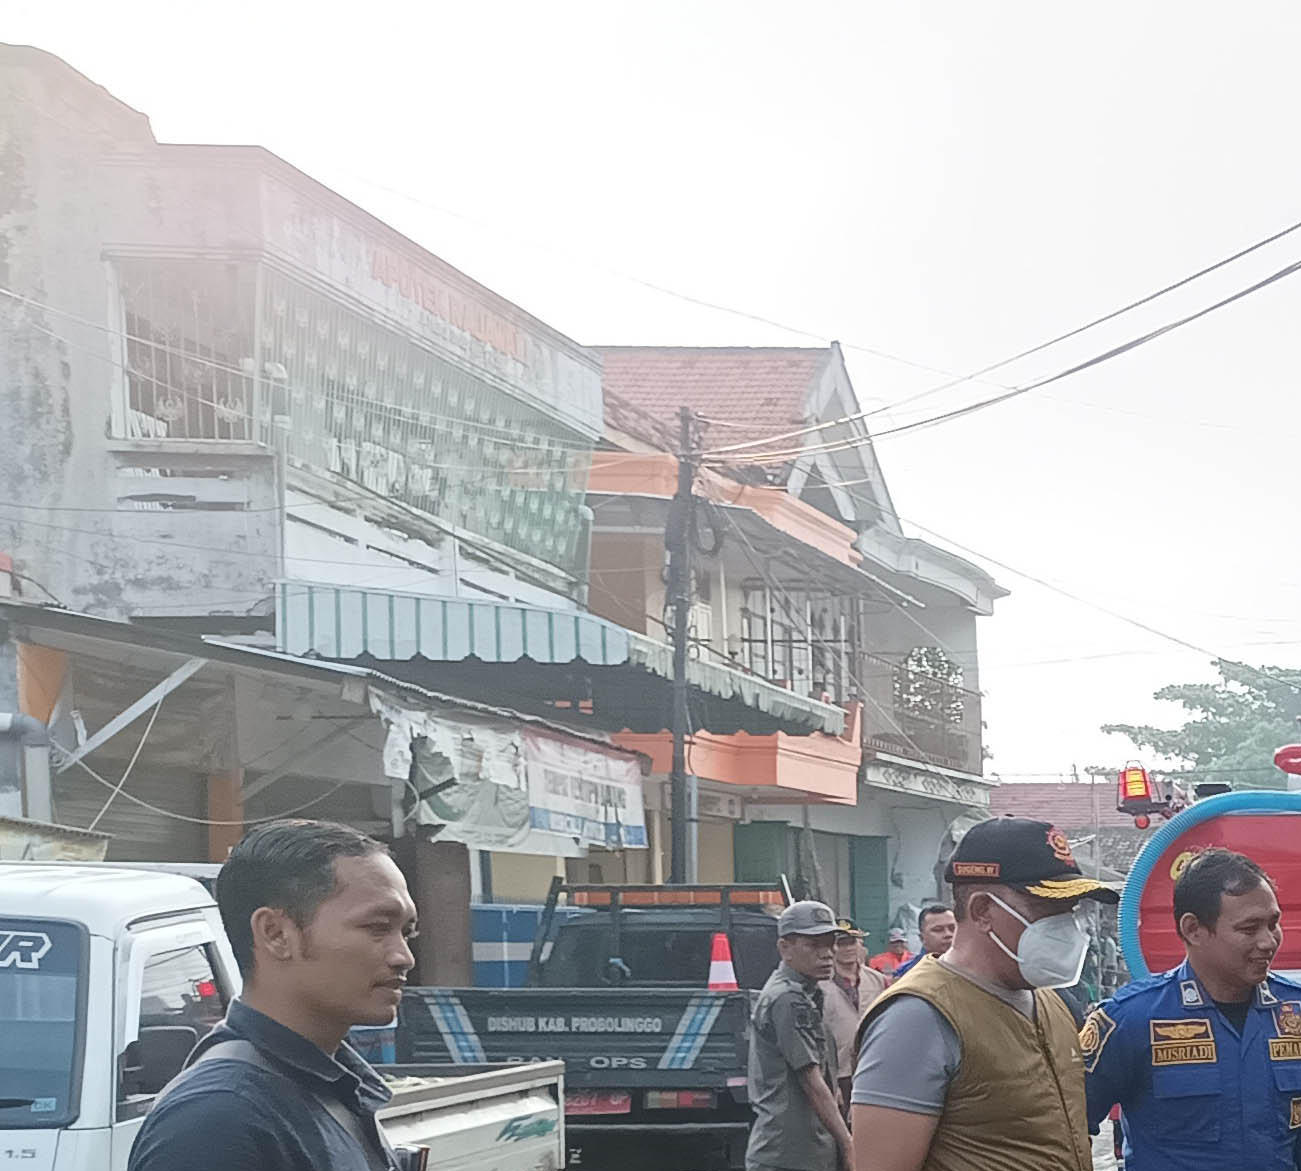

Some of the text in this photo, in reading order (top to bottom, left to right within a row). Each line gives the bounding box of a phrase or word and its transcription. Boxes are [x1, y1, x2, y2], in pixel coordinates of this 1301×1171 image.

[488, 1017, 662, 1033] DISHUB KAB. PROBOLINGGO
[590, 1057, 647, 1068] OPS
